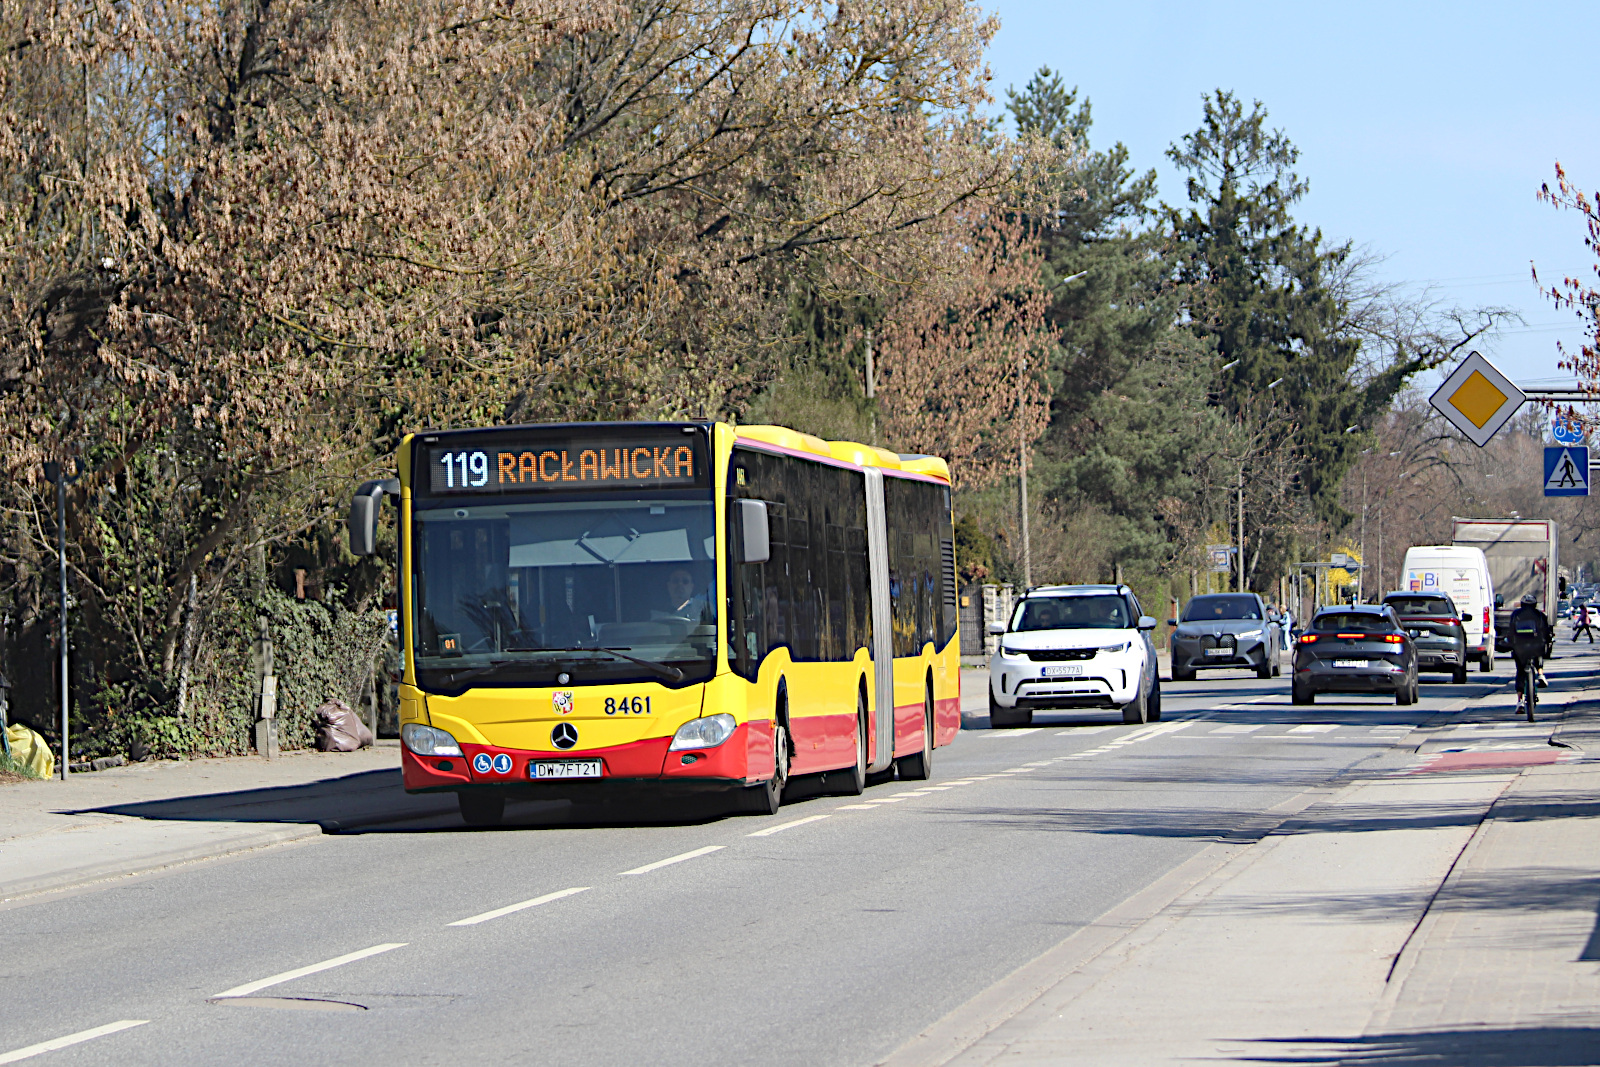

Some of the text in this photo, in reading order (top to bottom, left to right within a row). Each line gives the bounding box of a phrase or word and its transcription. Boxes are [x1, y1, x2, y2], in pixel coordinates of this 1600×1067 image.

[440, 451, 489, 488] 119
[497, 446, 693, 484] RACŁAWICKA
[604, 695, 652, 716] 8461
[538, 763, 597, 777] DW 7FT21
